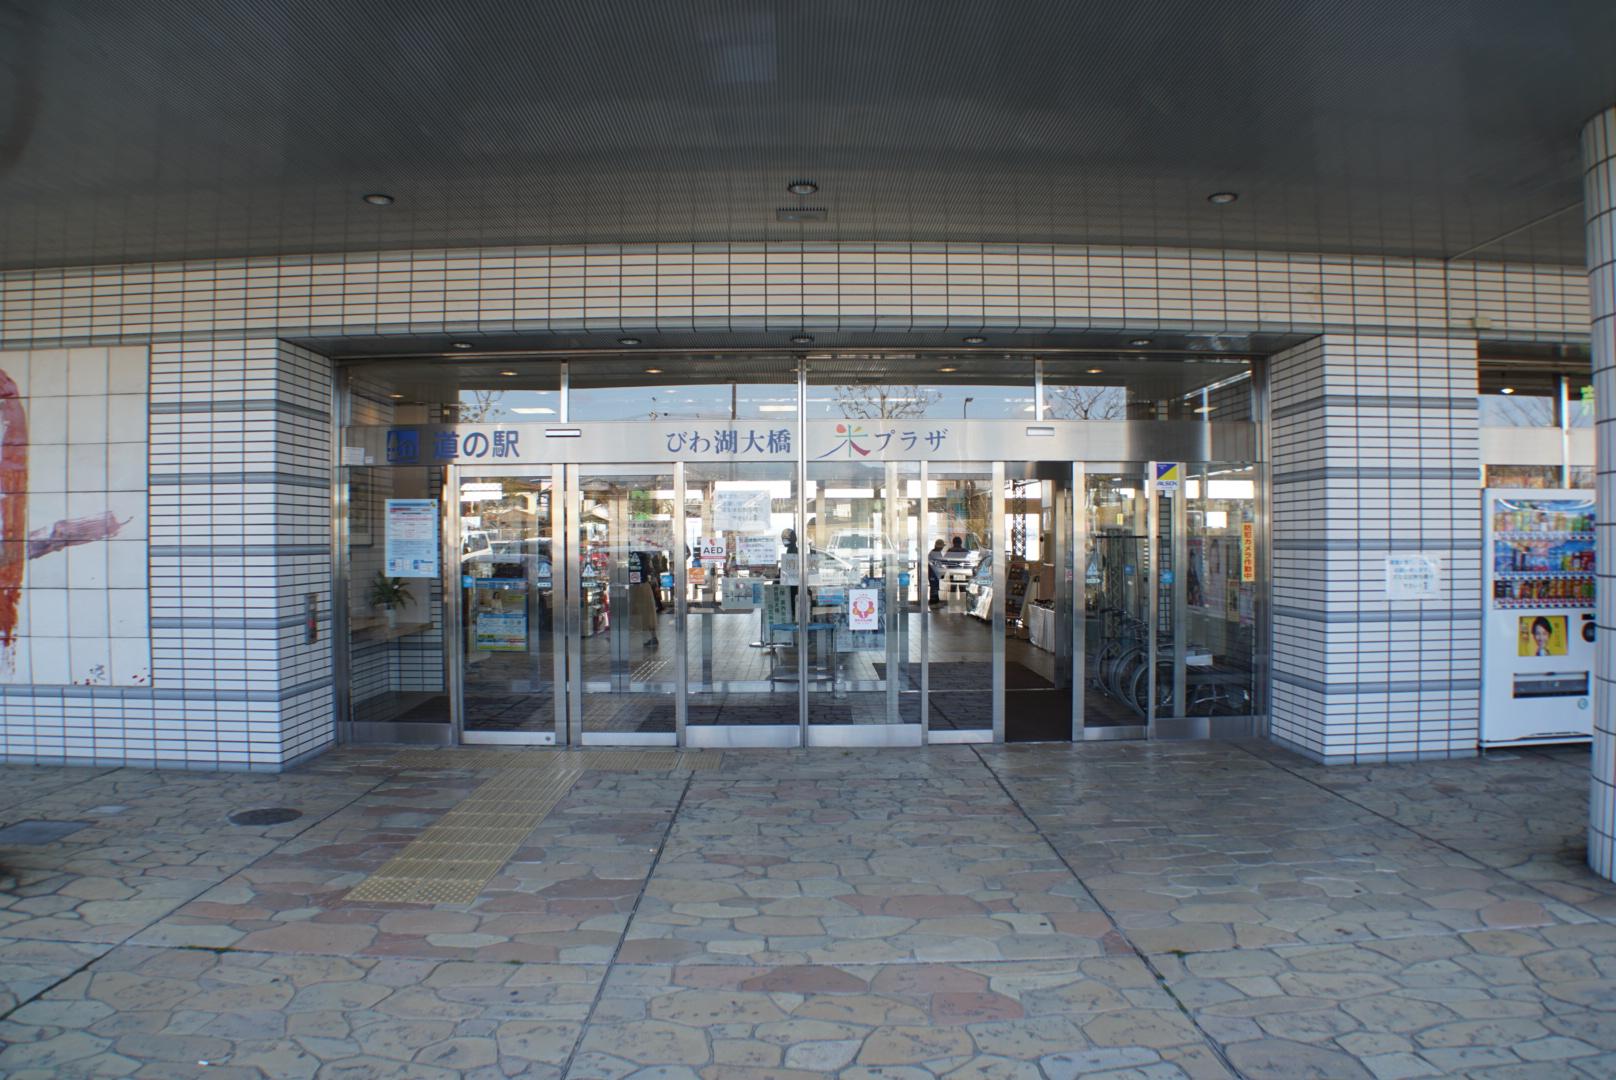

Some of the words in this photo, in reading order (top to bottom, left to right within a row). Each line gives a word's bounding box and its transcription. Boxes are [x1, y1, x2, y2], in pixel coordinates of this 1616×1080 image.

[433, 430, 520, 459] 道の駅
[666, 429, 792, 455] びわ湖大橋
[816, 423, 948, 459] 米プラザ
[703, 546, 724, 554] AED
